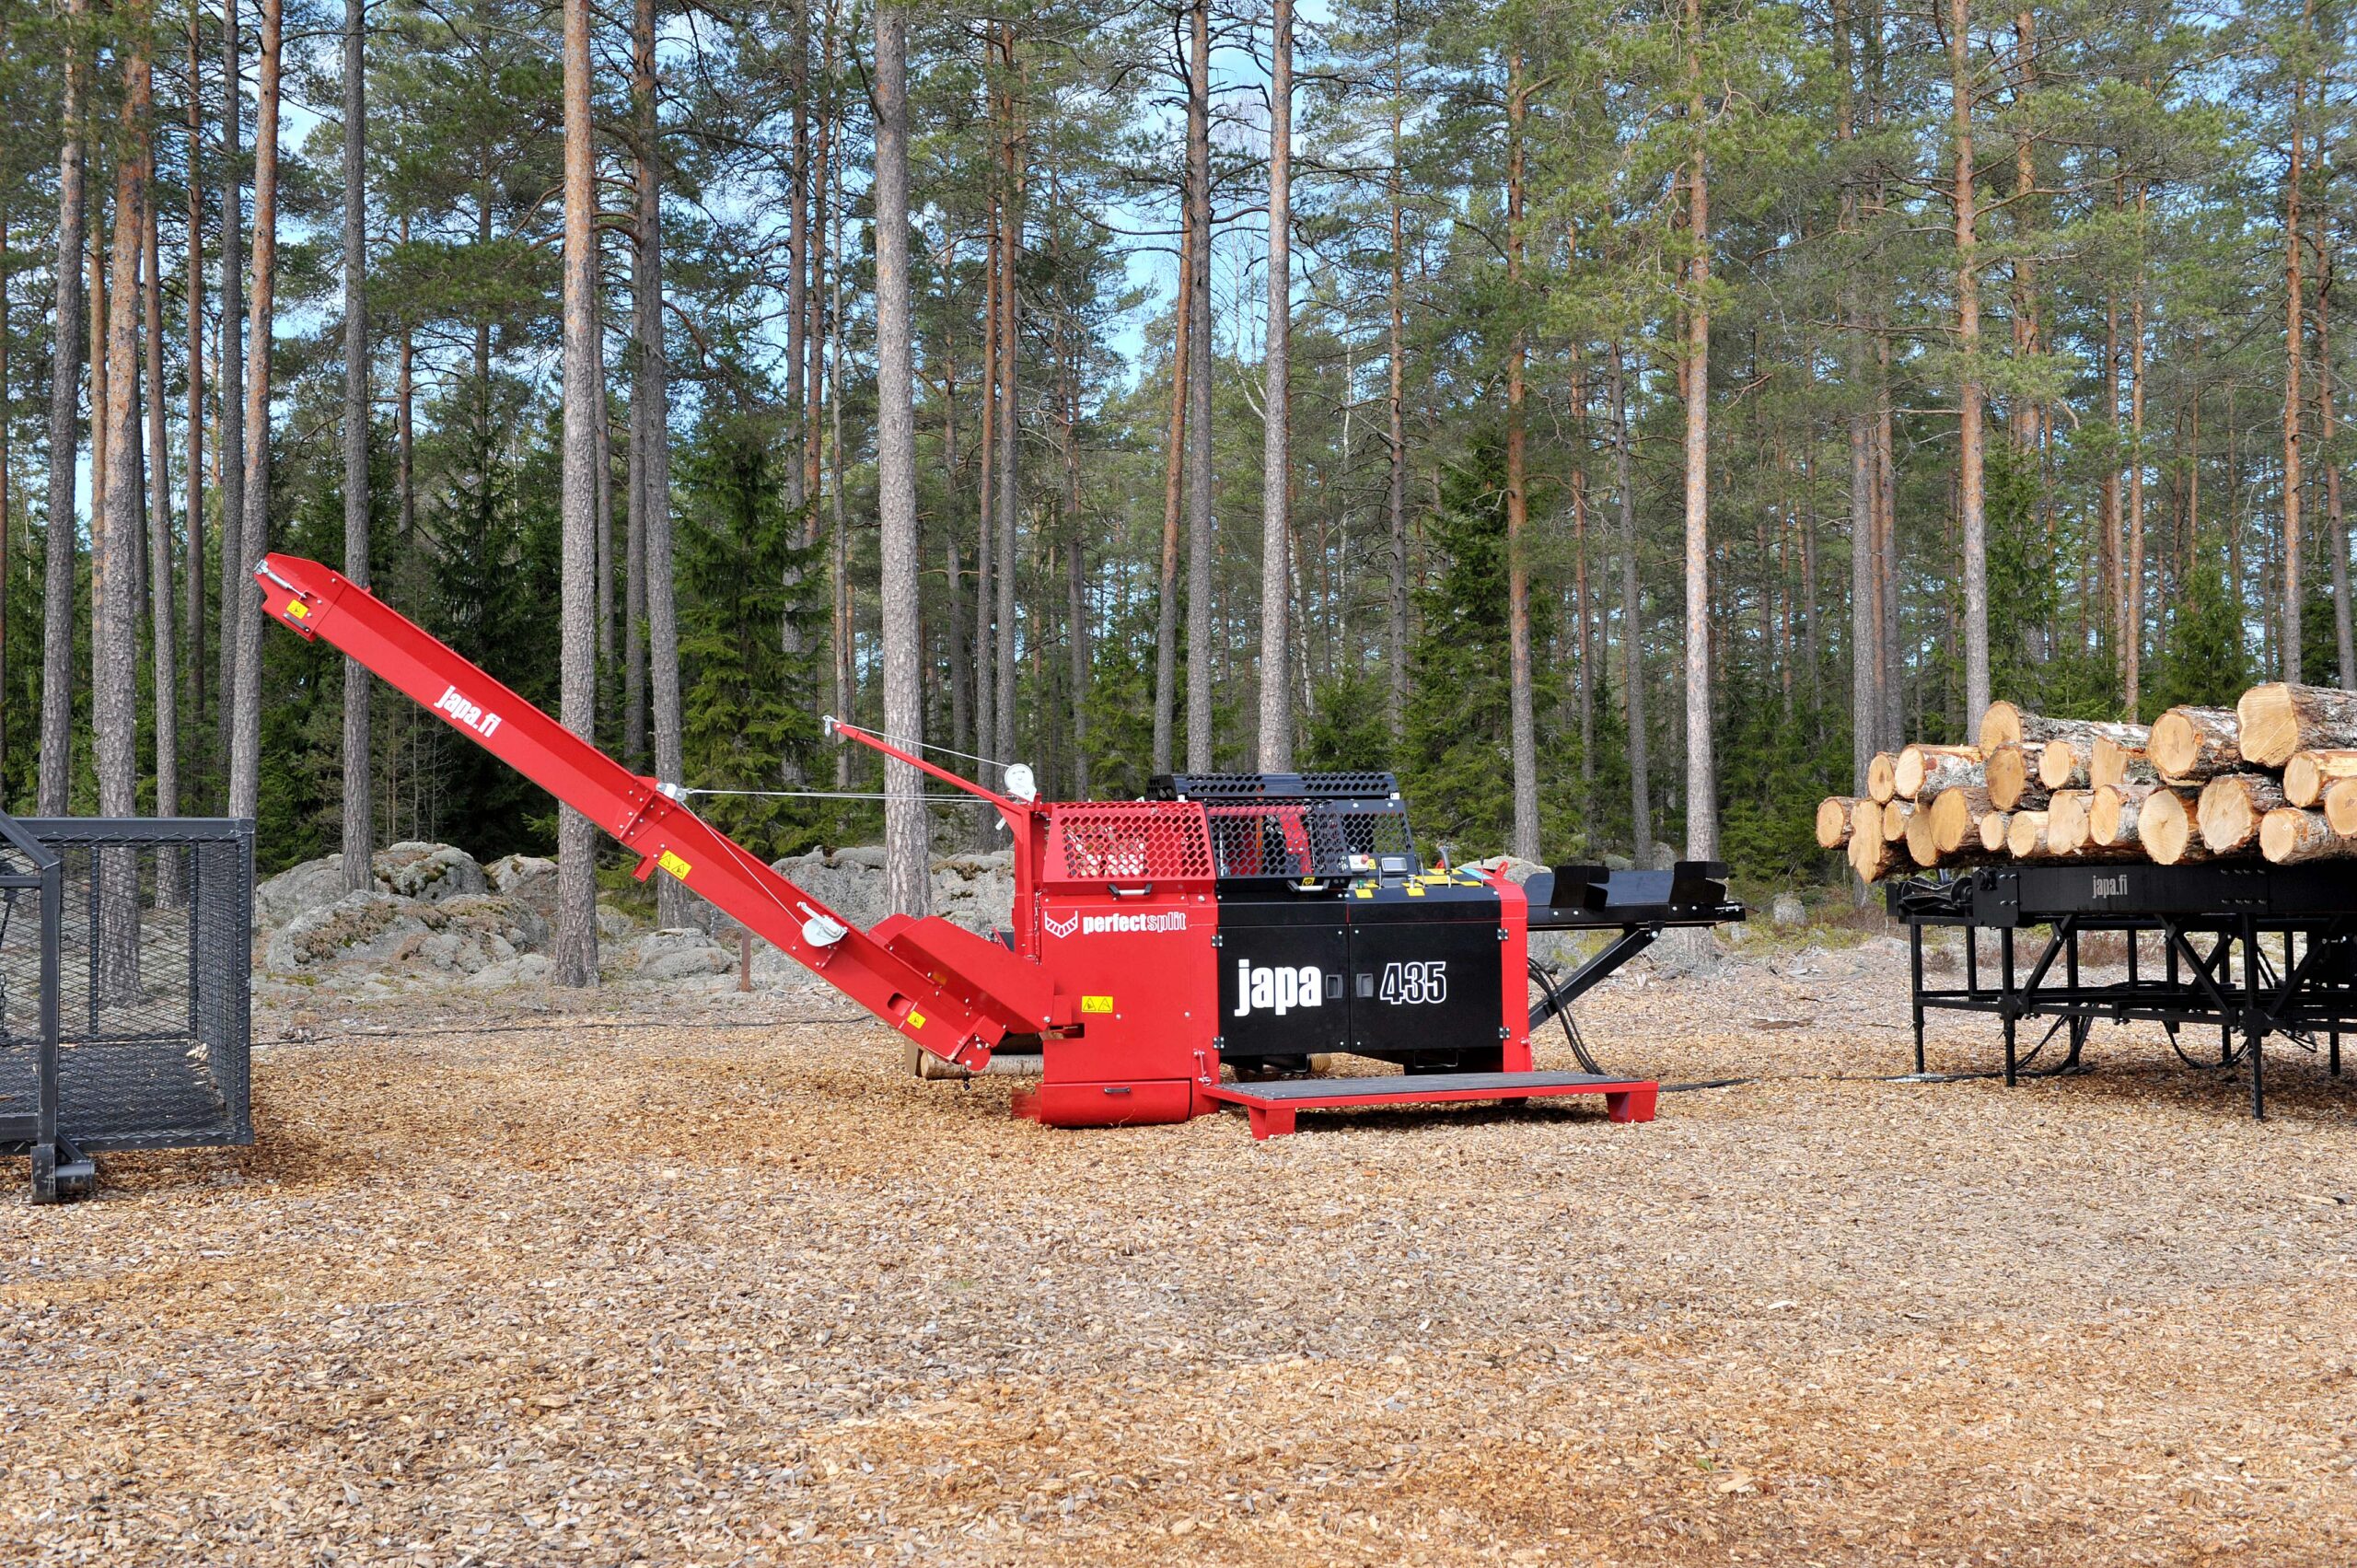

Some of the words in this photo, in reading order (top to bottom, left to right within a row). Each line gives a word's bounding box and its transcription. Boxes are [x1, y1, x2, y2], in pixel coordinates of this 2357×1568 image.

[434, 684, 502, 738] japa.fi
[2092, 874, 2128, 900] japa.fi
[1083, 911, 1187, 935] perfectsplit
[1234, 958, 1322, 1017] japa
[1379, 960, 1447, 1005] 435
